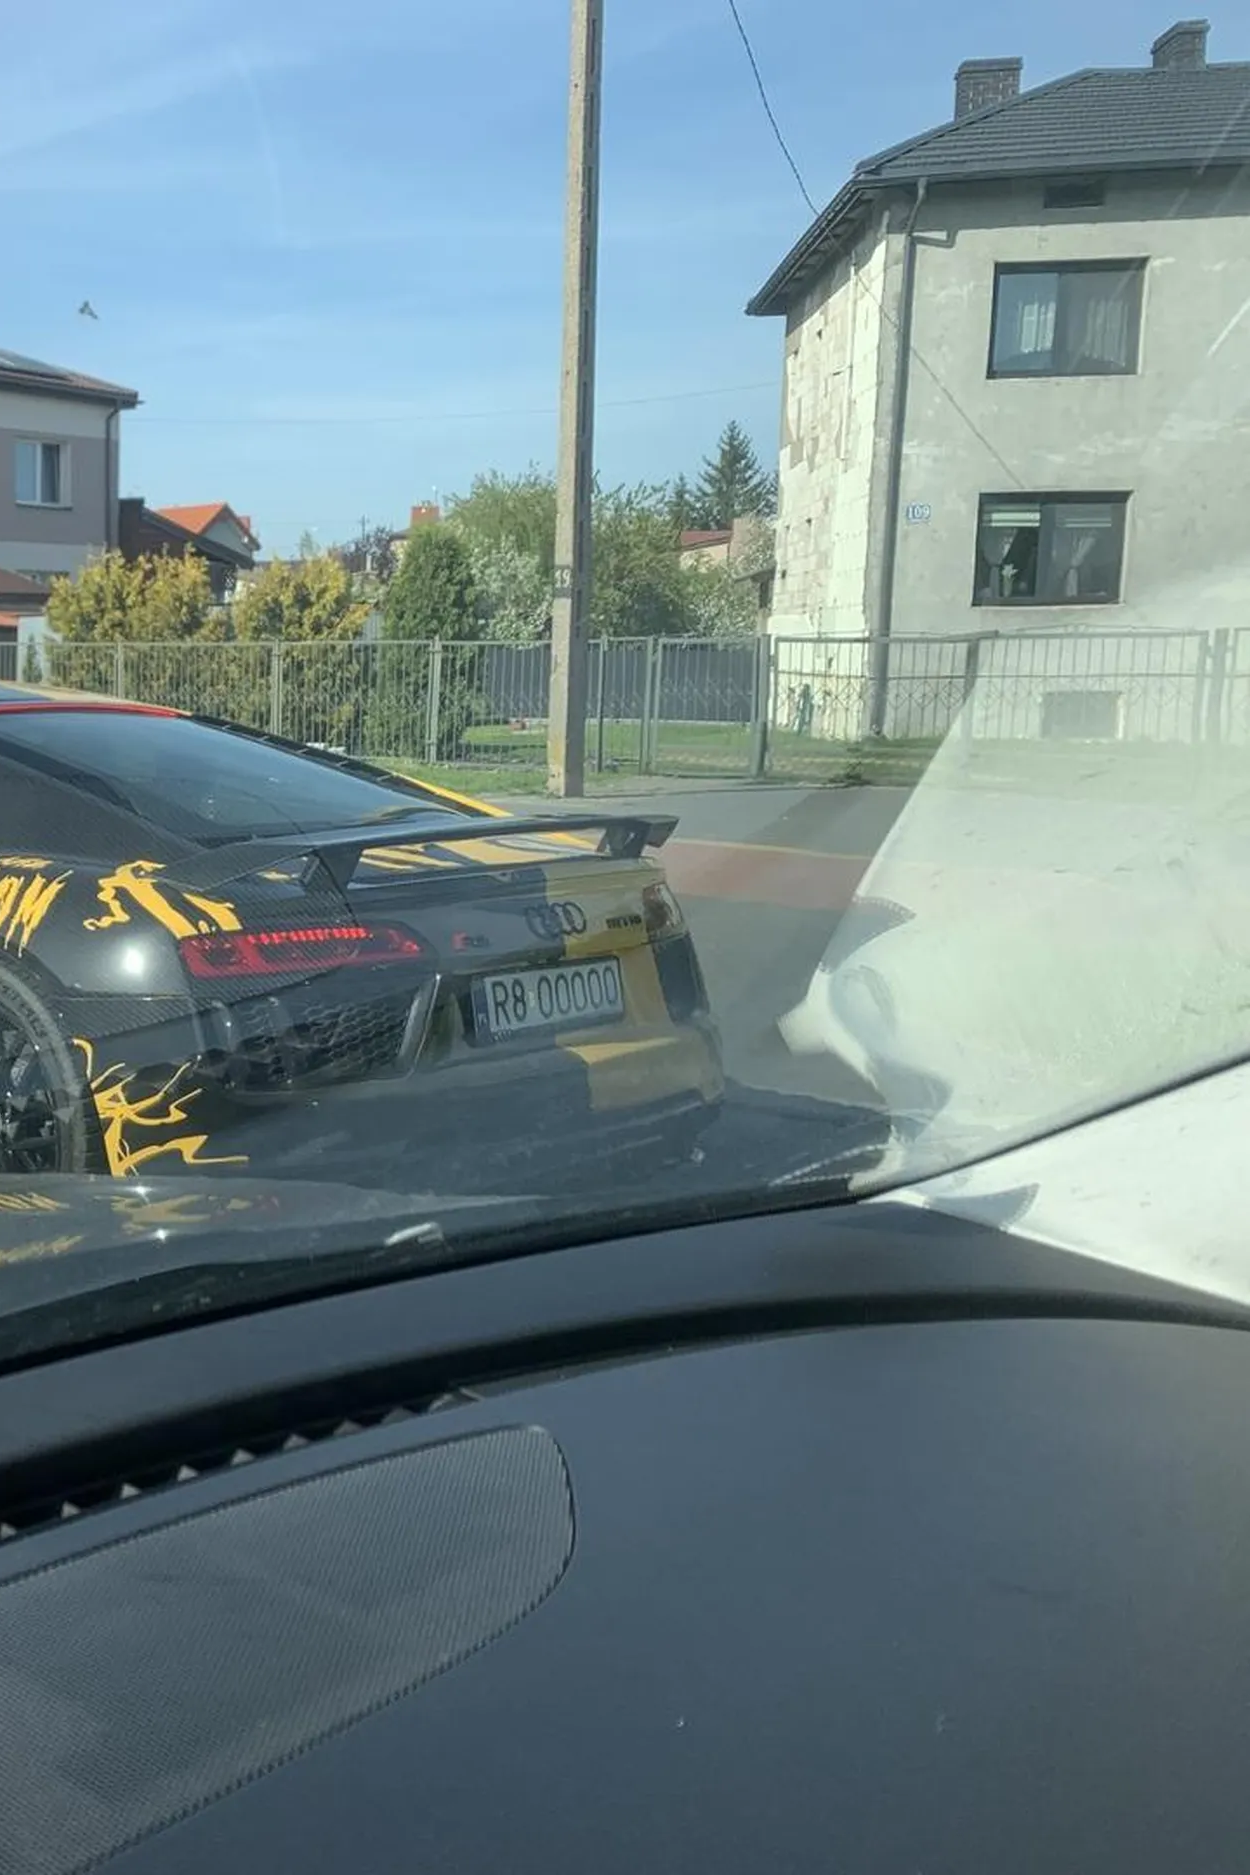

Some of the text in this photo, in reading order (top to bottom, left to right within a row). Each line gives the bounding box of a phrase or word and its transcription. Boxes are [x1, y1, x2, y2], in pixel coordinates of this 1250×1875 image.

[908, 504, 930, 519] 109
[491, 965, 619, 1026] R8 00000
